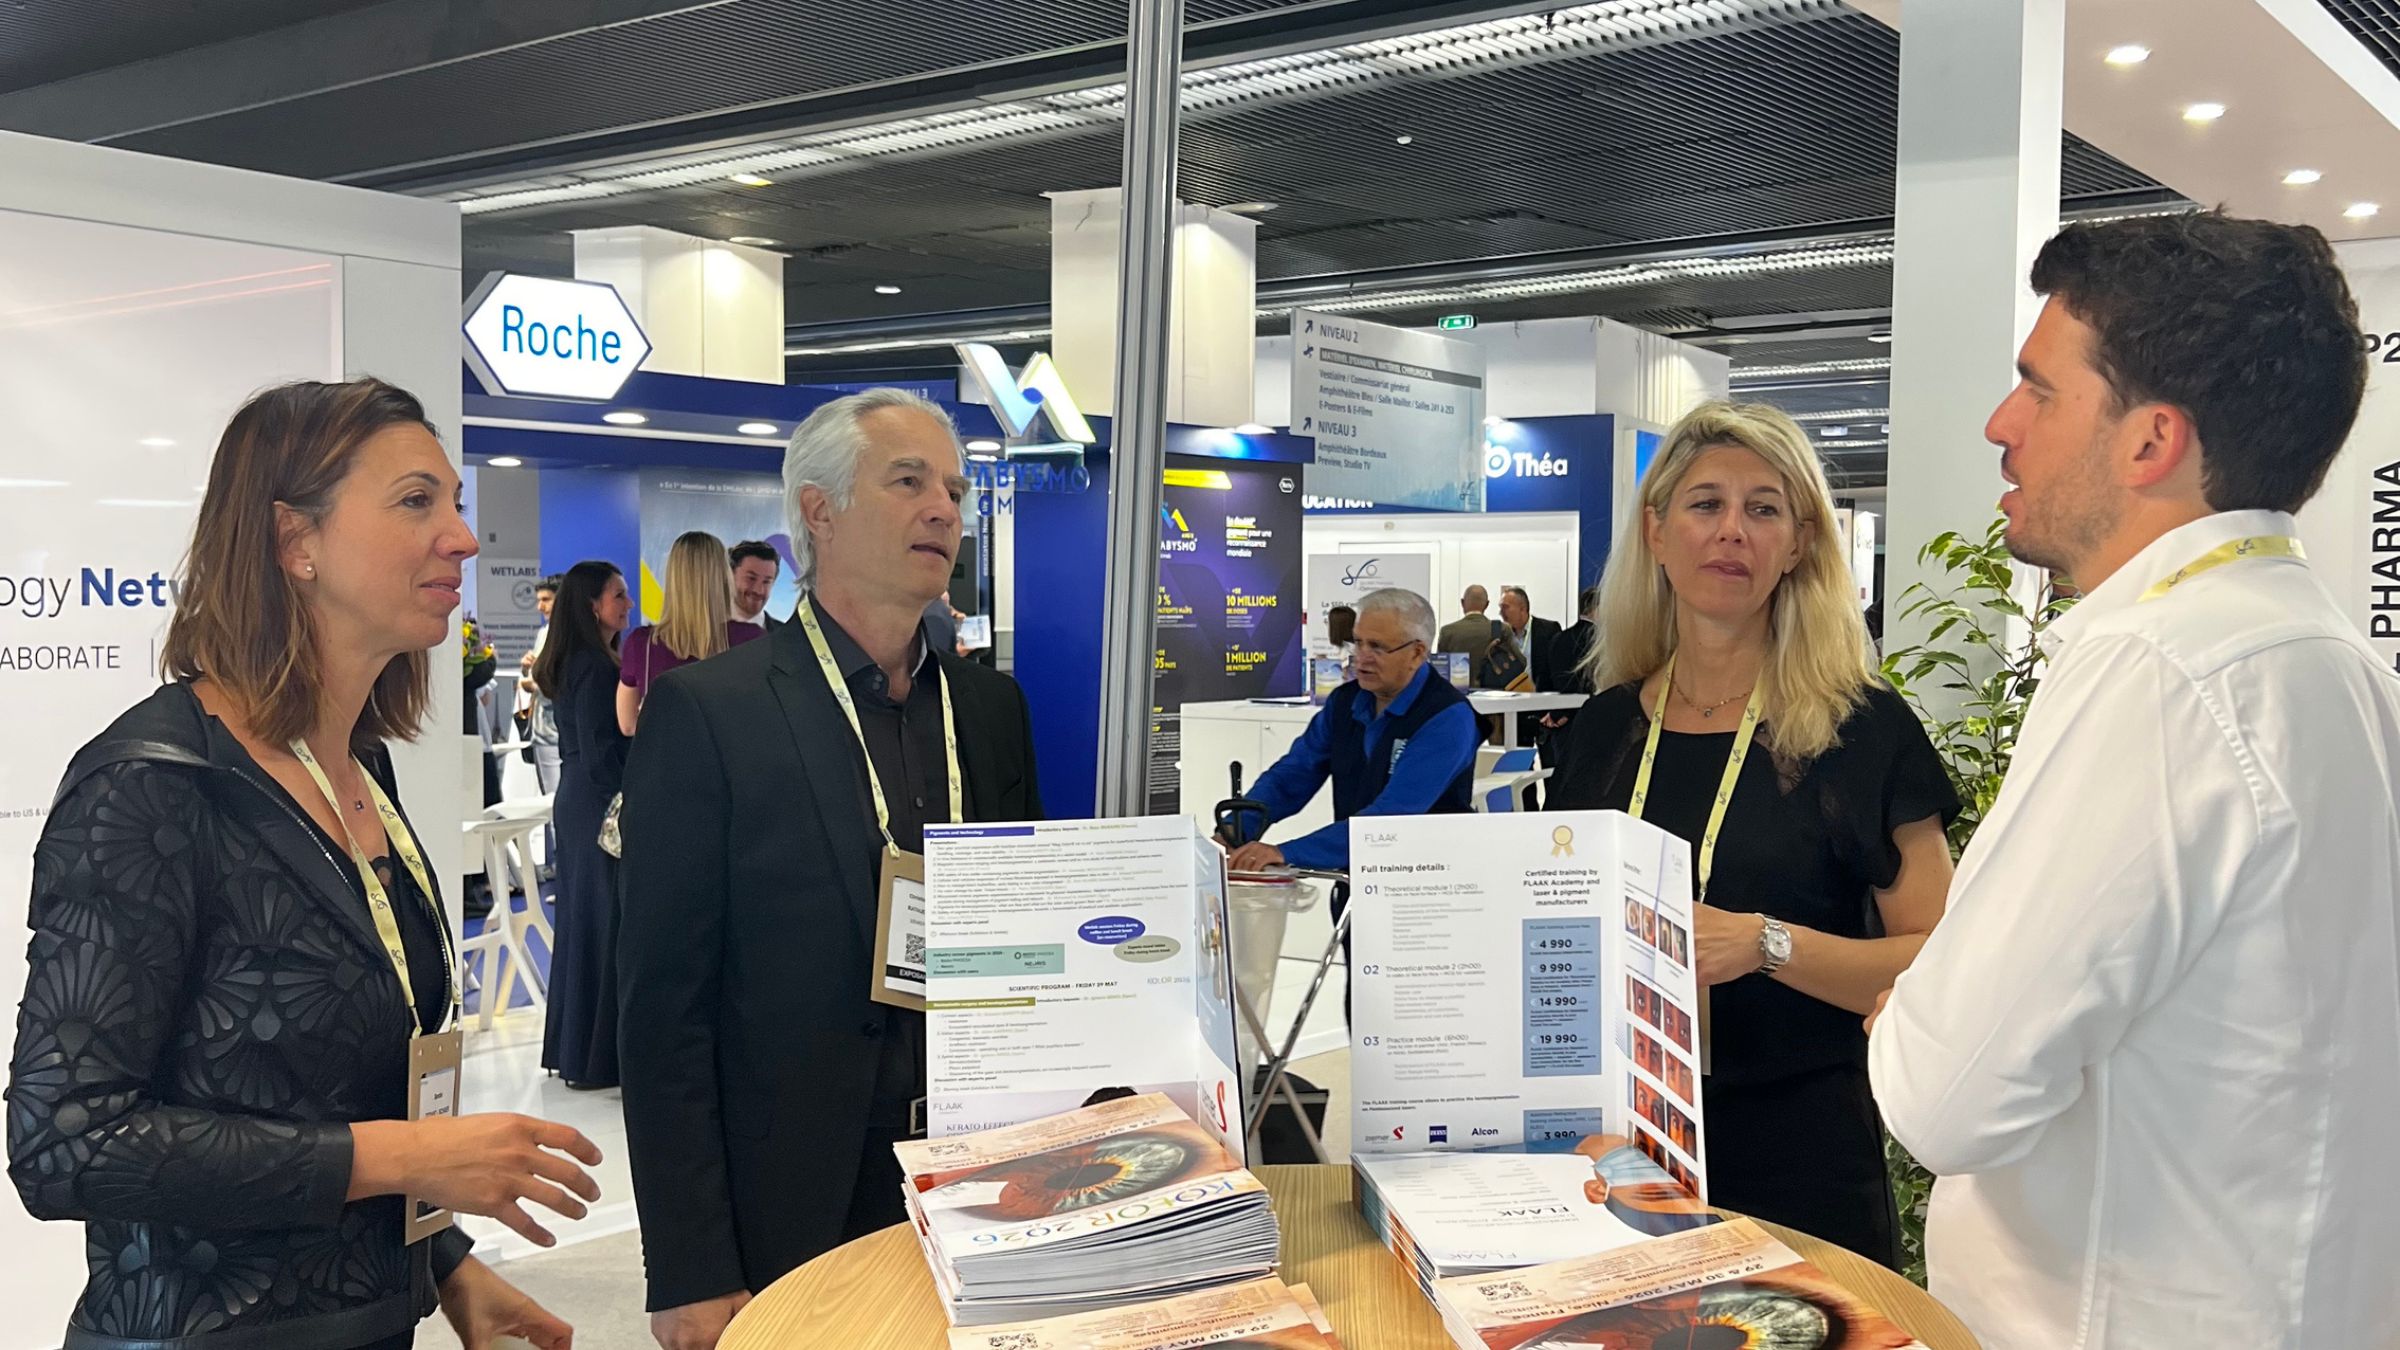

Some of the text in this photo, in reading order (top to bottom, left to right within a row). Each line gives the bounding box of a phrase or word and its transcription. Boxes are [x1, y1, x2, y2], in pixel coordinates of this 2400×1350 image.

[503, 304, 621, 364] Roche
[1320, 324, 1359, 343] NIVEAU 2
[1318, 421, 1357, 437] NIVEAU 3
[1515, 453, 1568, 477] Théa
[490, 566, 537, 577] WETLABS
[1226, 595, 1278, 607] 10 MILLIONS
[0, 645, 120, 670] ABORATE
[1231, 652, 1267, 663] MILLION
[1364, 833, 1399, 842] FLAAK
[1361, 865, 1378, 873] Full
[1379, 864, 1414, 873] training
[1415, 863, 1445, 872] details
[1559, 869, 1587, 877] training
[1523, 879, 1549, 887] FLAAK
[1551, 879, 1584, 887] Academy
[1364, 884, 1378, 895] 01
[1559, 888, 1590, 897] pigment
[1535, 898, 1588, 906] manufacturers
[1539, 938, 1573, 949] 4 990
[1362, 964, 1380, 976] 02
[1539, 962, 1573, 973] 9 990
[1539, 996, 1577, 1007] 14 990
[1362, 1035, 1380, 1047] 03
[1540, 1034, 1578, 1044] 19 990
[933, 1103, 964, 1111] FLAAK
[946, 1123, 981, 1131] KERATO
[1471, 1127, 1499, 1137] Alcon
[1543, 1131, 1551, 1142] 3
[1497, 1206, 1570, 1218] FLAAK
[972, 1221, 1073, 1248] 2026
[1446, 1251, 1518, 1261] FLAAK
[1745, 1264, 1764, 1273] 29
[1705, 1273, 1725, 1281] 30
[1667, 1278, 1703, 1291] MAY
[1624, 1288, 1663, 1300] 2026
[1567, 1299, 1610, 1310] Nice,
[1511, 1308, 1565, 1320] France
[1250, 1323, 1270, 1332] 29
[1209, 1331, 1229, 1341] 30
[1168, 1336, 1205, 1349] MAY
